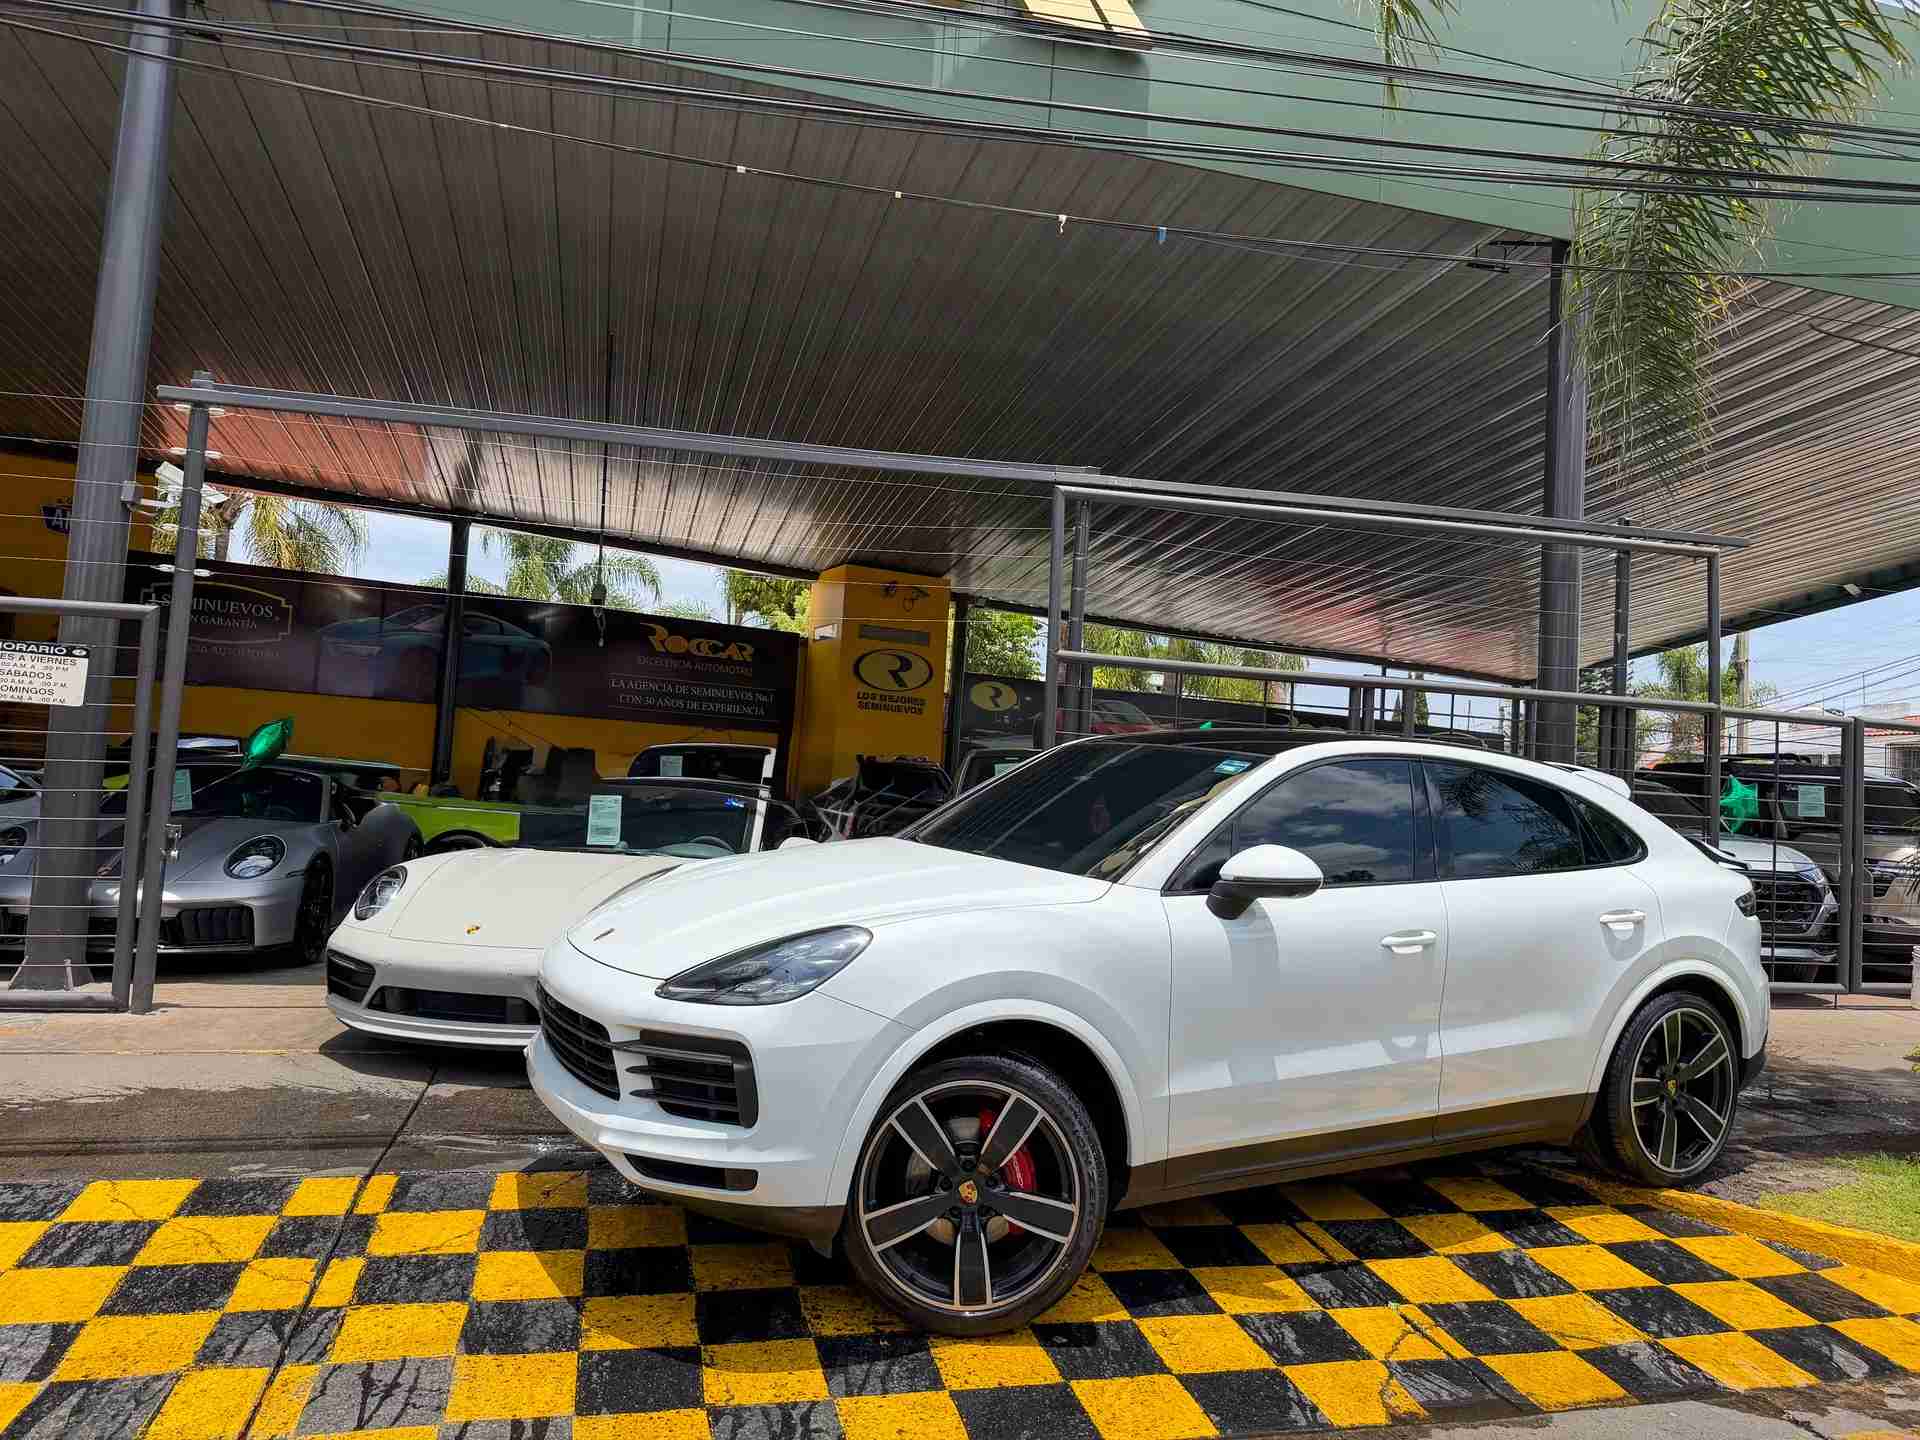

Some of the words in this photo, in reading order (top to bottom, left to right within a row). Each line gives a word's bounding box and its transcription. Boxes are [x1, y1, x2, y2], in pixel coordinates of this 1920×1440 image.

[161, 593, 273, 618] SINUEVOS
[0, 641, 67, 655] ORARIO
[640, 622, 754, 662] ROCCAR
[18, 654, 26, 662] A
[30, 655, 77, 667] VIERNES
[0, 684, 55, 696] OMINGOS
[690, 686, 753, 701] SEMINUEVOS
[857, 691, 876, 701] LOS
[857, 701, 924, 716] SEMINUEVOS
